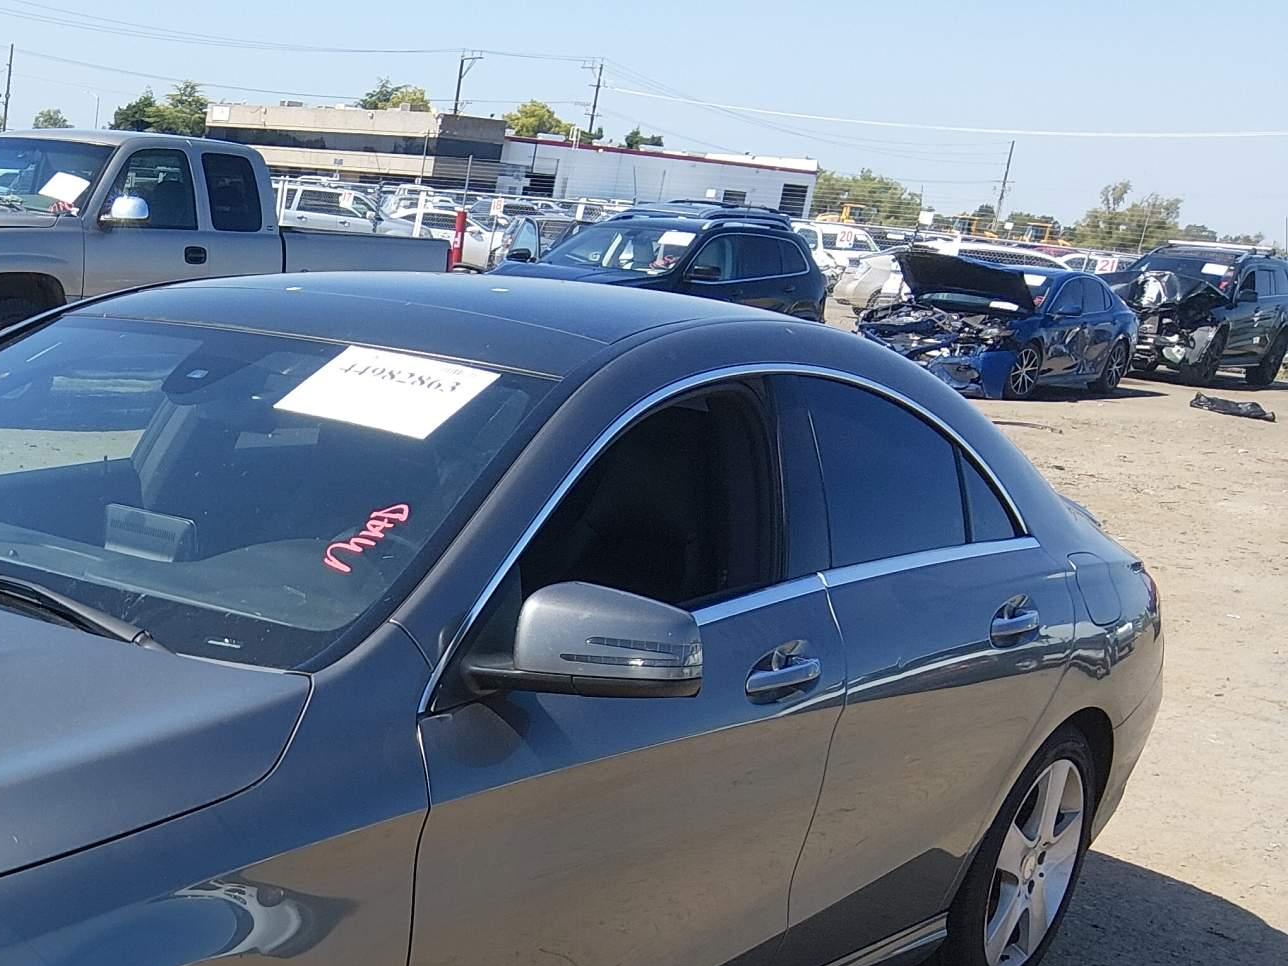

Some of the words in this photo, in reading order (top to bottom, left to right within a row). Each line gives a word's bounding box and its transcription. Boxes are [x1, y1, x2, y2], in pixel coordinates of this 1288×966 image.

[493, 199, 503, 210] 18
[840, 231, 853, 242] 20
[1098, 259, 1116, 272] 21
[339, 363, 461, 392] 44982863
